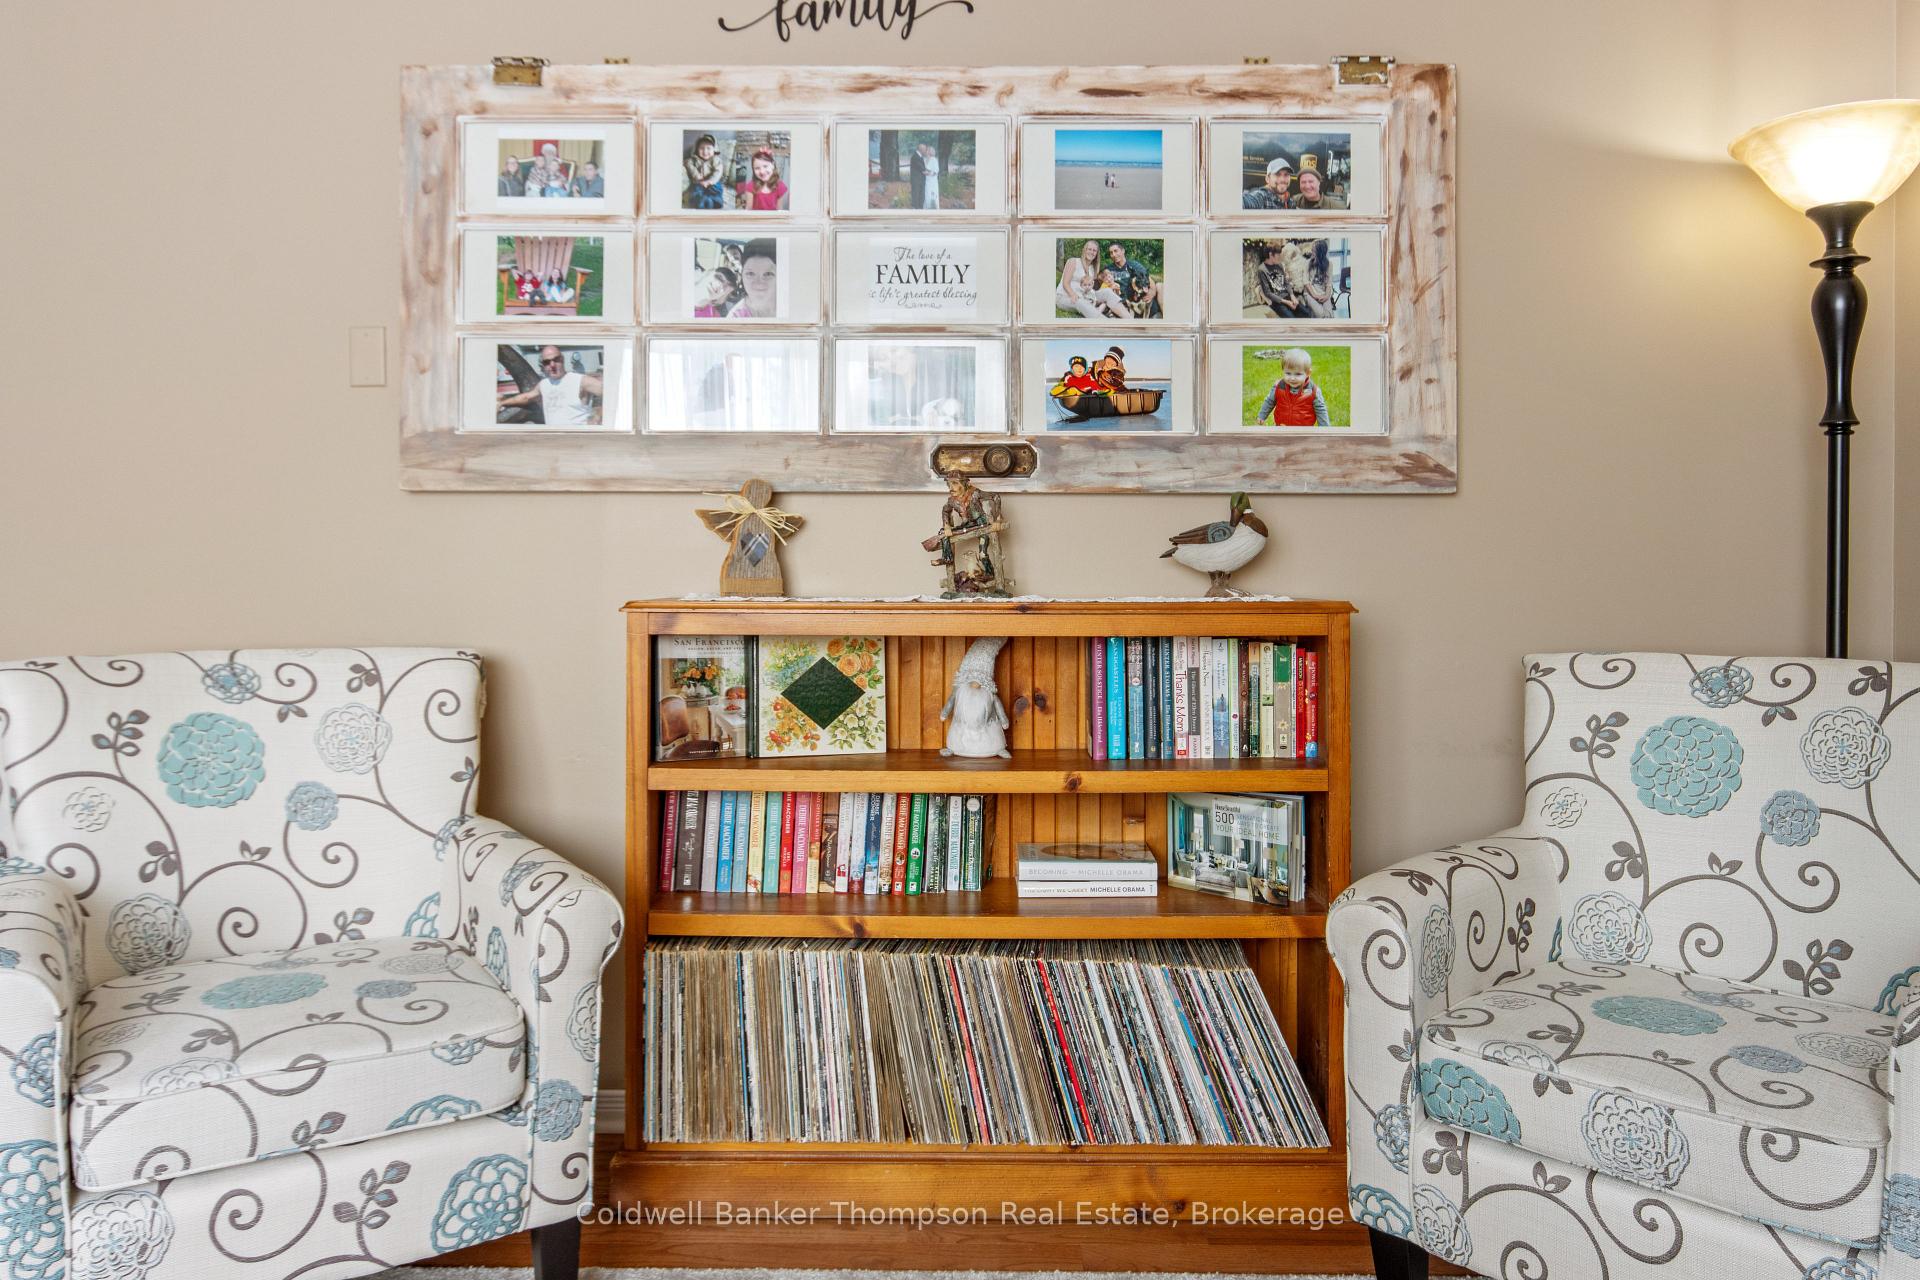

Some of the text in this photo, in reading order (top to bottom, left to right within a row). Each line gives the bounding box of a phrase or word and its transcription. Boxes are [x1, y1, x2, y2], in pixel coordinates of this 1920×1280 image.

[894, 247, 915, 262] The
[918, 249, 933, 260] love
[937, 248, 947, 264] of
[876, 264, 971, 284] FAMILY
[868, 287, 978, 306] is life's greatest blessing
[1176, 670, 1187, 731] Thanks Mom
[724, 803, 732, 823] DEBBIE
[738, 804, 747, 824] DEBBIE
[770, 802, 779, 822] DEBBIE
[798, 805, 807, 826] DEBBIE
[1215, 812, 1234, 824] 500
[752, 814, 760, 848] MACOMBER
[885, 817, 893, 837] DEBBIE
[897, 797, 907, 850] DEBBIE MACOMBER
[912, 814, 920, 844] MACOMBER
[1216, 824, 1280, 840] YOUR IDEAL HOME
[722, 825, 731, 860] MACOMBER
[736, 826, 746, 860] MACOMBER
[768, 825, 777, 860] MACOMBER
[797, 828, 806, 862] MACOMBER
[950, 821, 960, 870] DEBBIE MACOMBER
